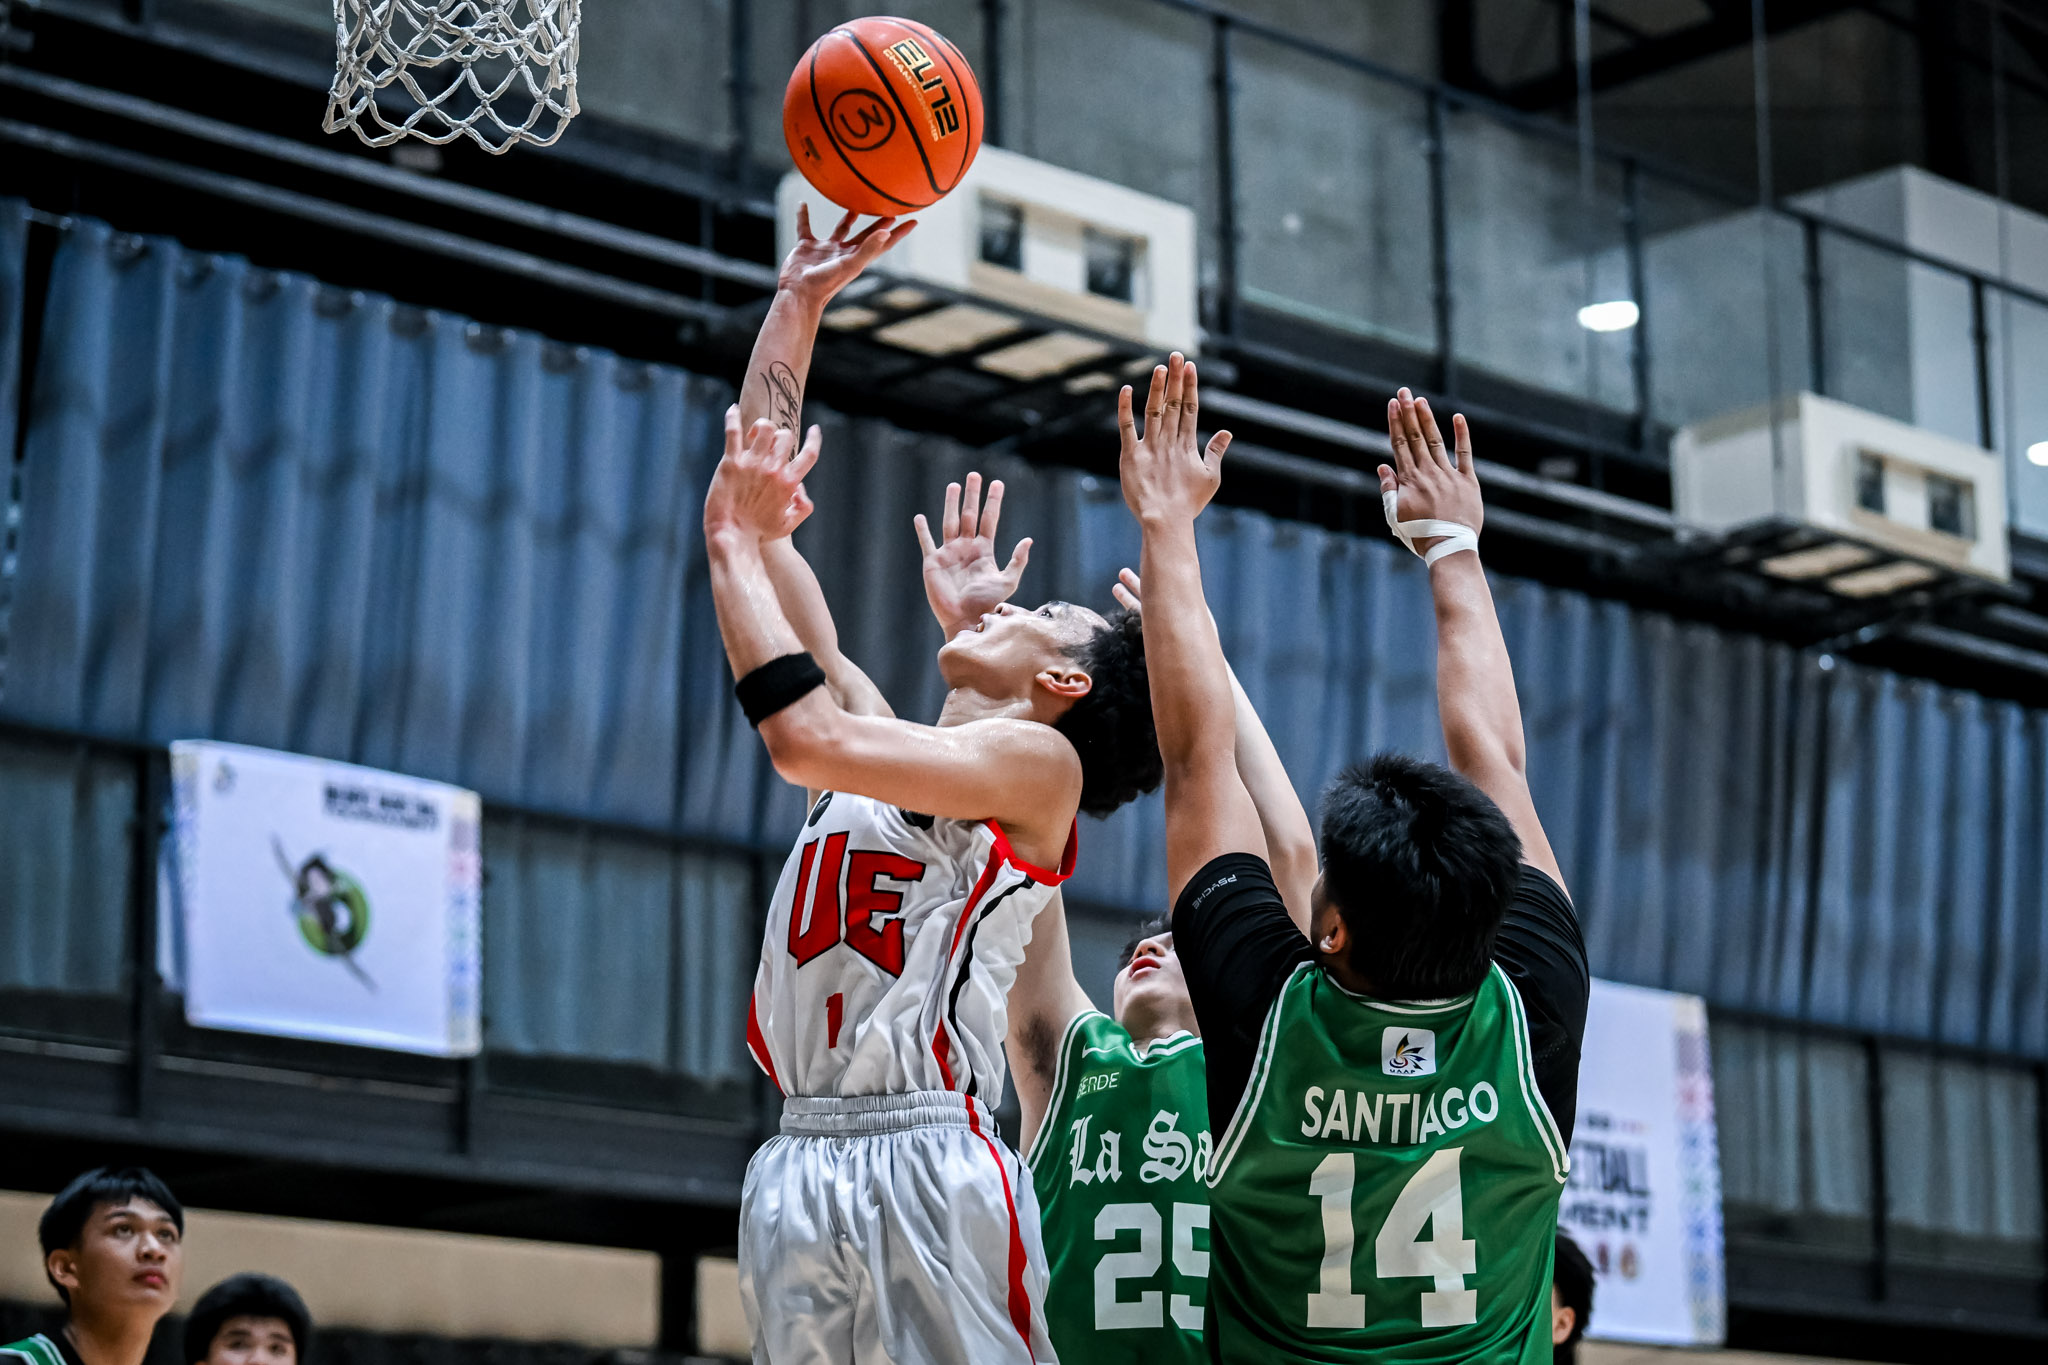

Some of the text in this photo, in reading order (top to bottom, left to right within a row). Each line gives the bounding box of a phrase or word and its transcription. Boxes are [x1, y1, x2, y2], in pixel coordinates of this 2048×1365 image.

[838, 102, 885, 140] 3
[889, 37, 960, 138] ELITE
[787, 830, 926, 980] UE
[1192, 873, 1238, 910] PSYCHE
[825, 992, 844, 1049] 1
[1301, 1080, 1500, 1145] SANTIAGO
[1069, 1113, 1123, 1190] La
[1093, 1202, 1211, 1331] 25
[1306, 1147, 1478, 1329] 14
